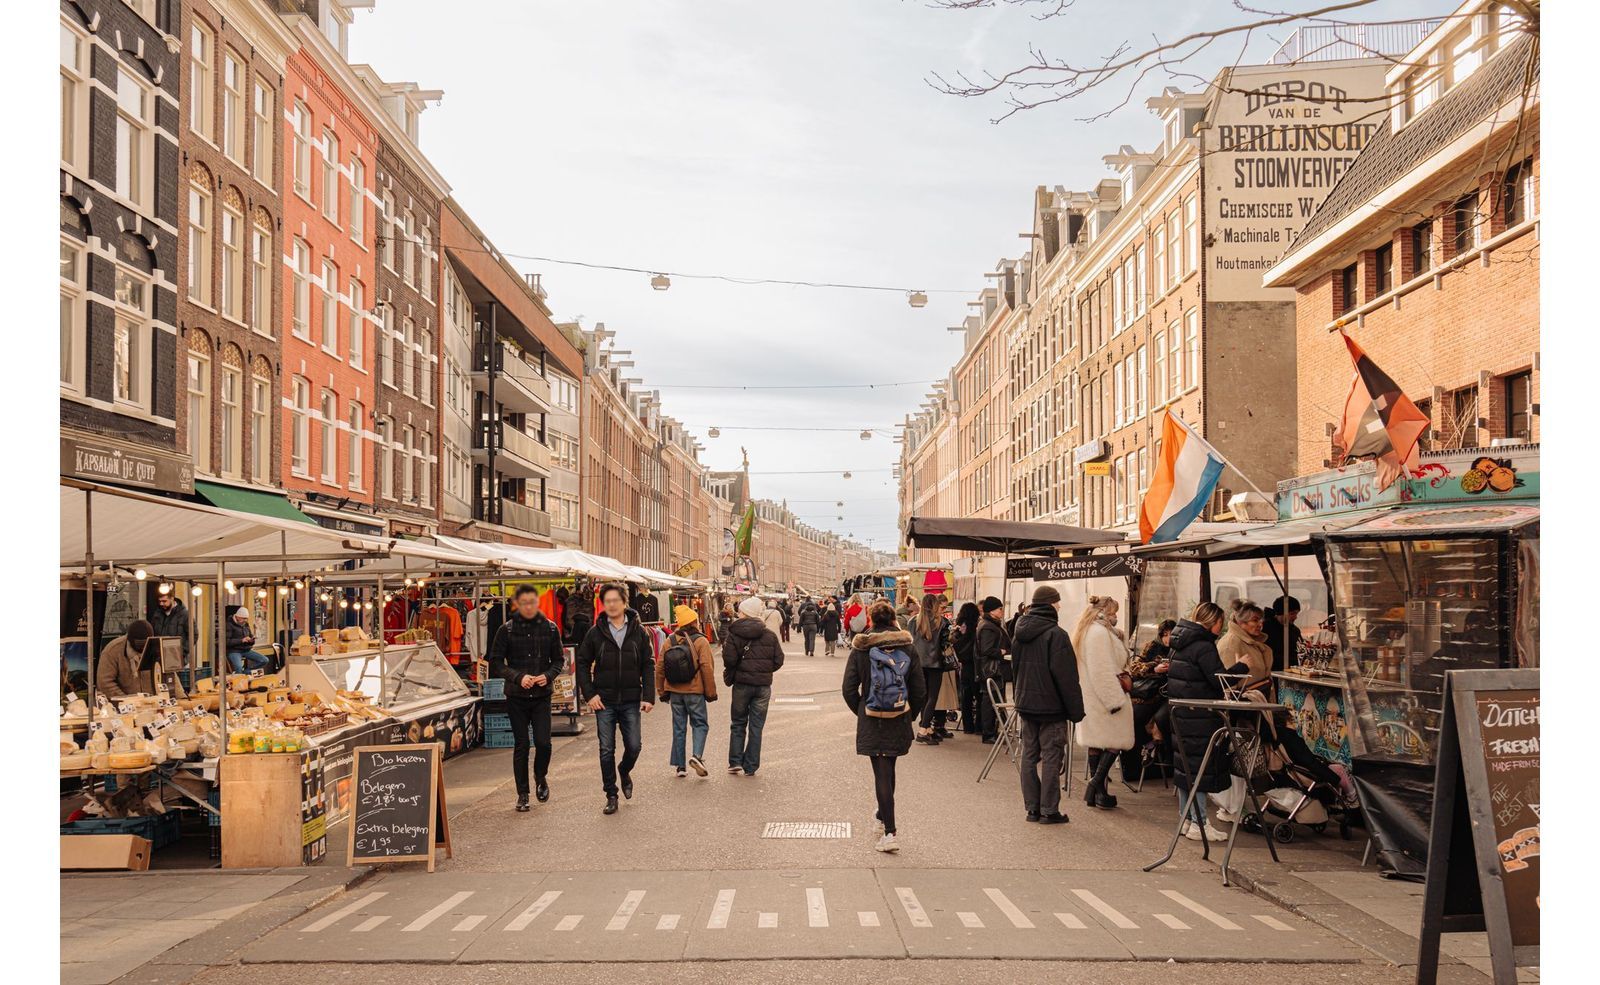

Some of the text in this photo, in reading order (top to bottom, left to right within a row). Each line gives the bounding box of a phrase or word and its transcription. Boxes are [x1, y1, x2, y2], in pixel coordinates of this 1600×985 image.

[1245, 80, 1347, 117] DEPOT
[1269, 108, 1321, 118] VAN DE
[1224, 227, 1280, 243] Machinale
[1293, 485, 1323, 513] Dutch
[1483, 703, 1540, 727] DUTCH
[360, 779, 406, 795] Belegen
[1496, 791, 1524, 827] BEST
[356, 823, 429, 838] Extra belegen
